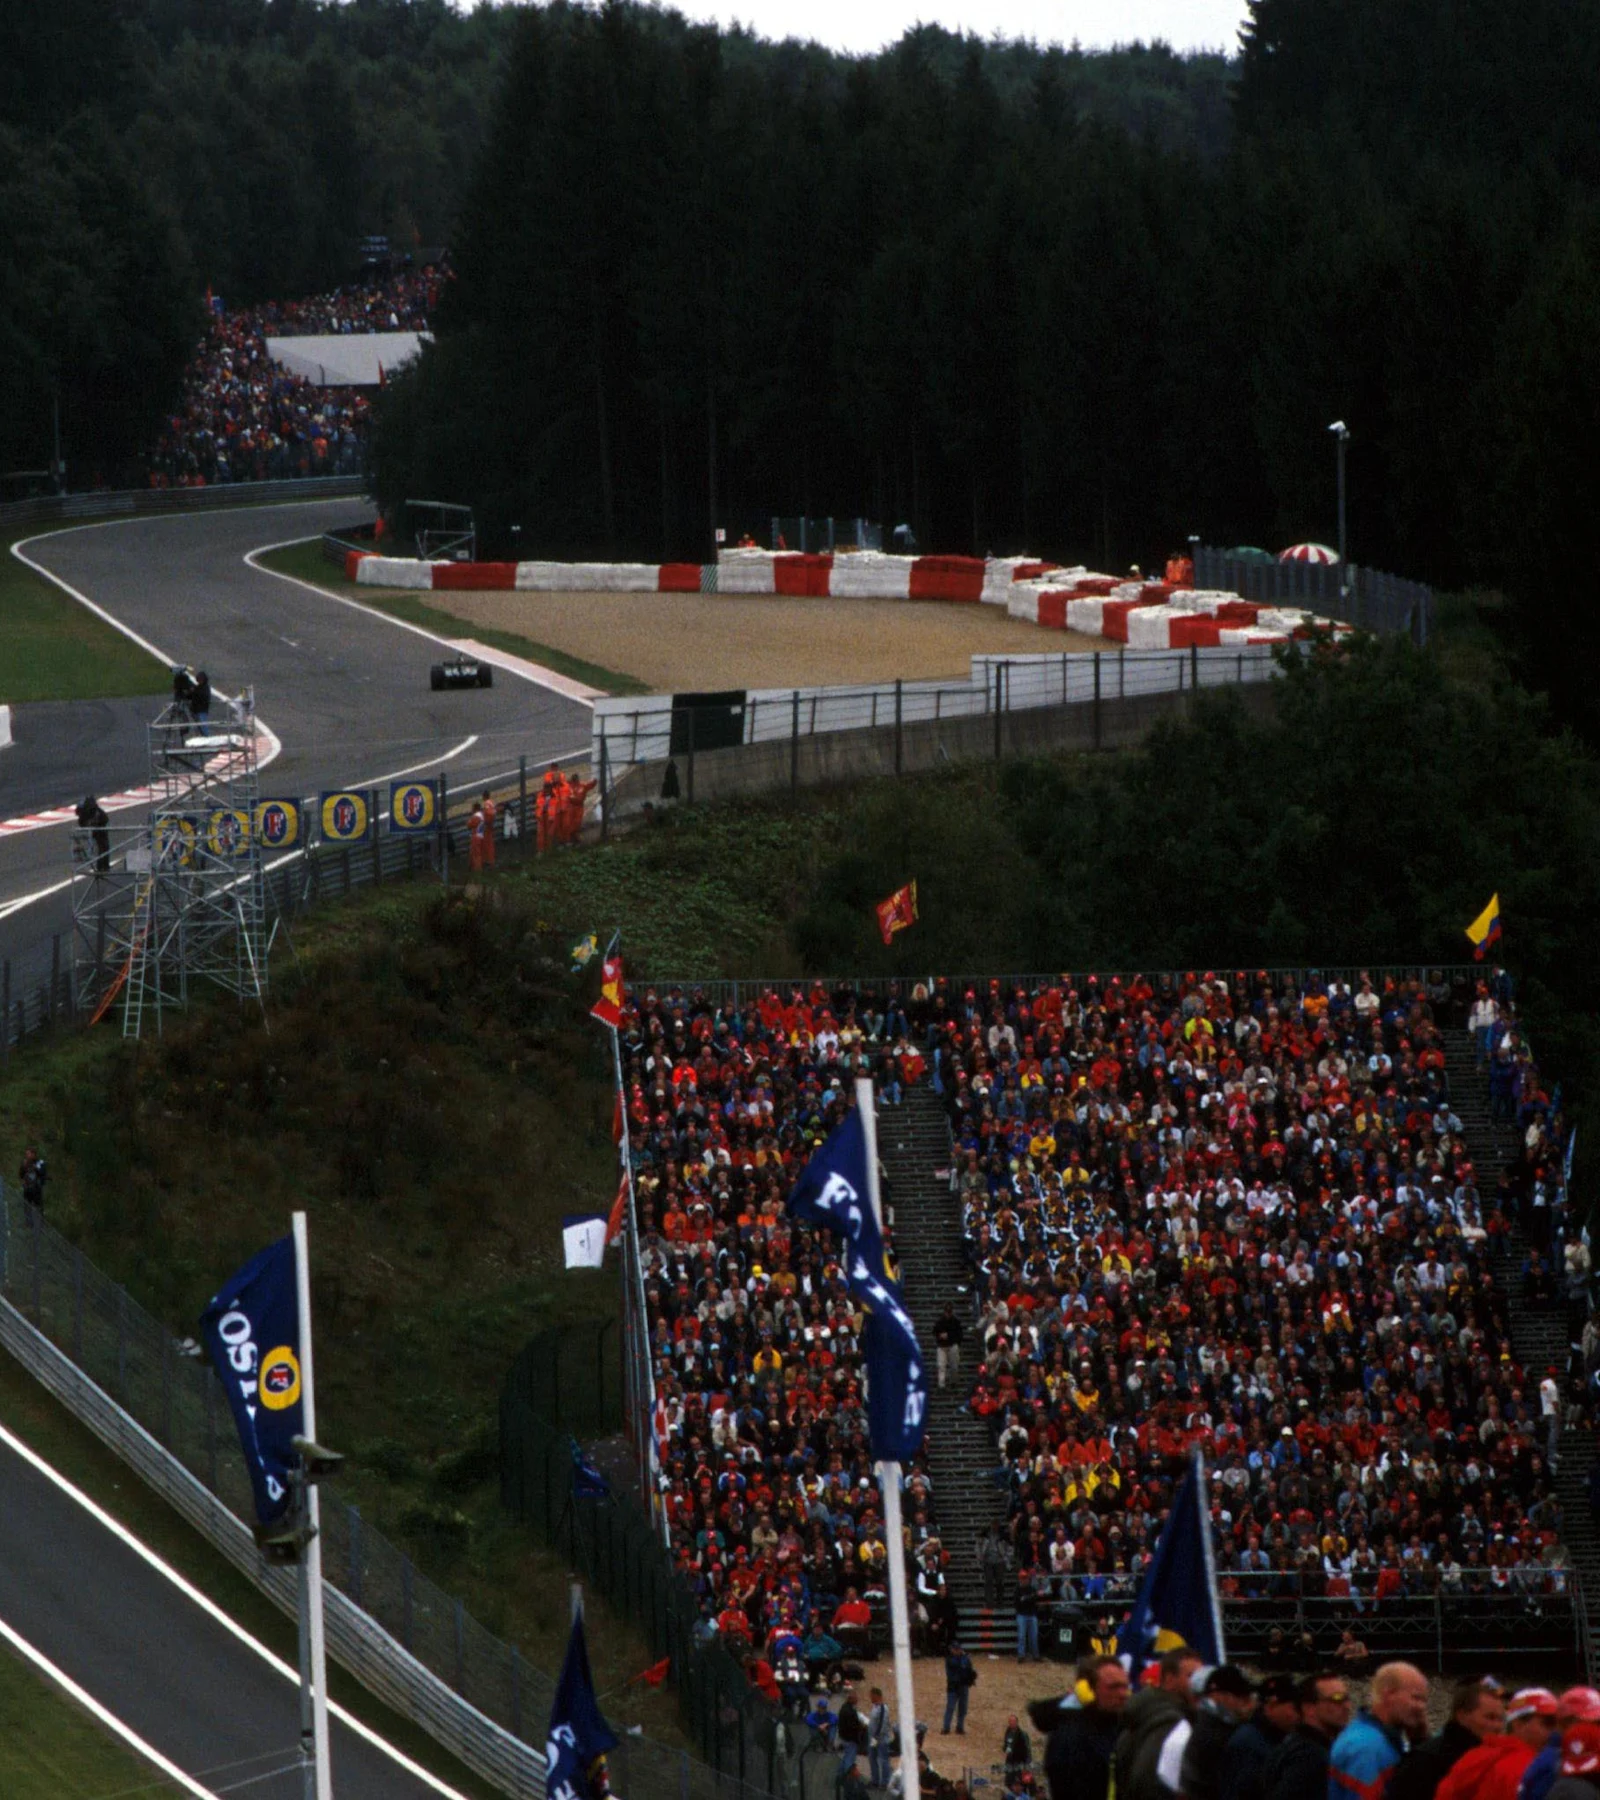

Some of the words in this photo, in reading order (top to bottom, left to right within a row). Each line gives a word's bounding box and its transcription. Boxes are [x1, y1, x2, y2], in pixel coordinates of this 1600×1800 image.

[337, 805, 353, 829] F
[406, 795, 422, 818] F
[265, 812, 285, 837] F
